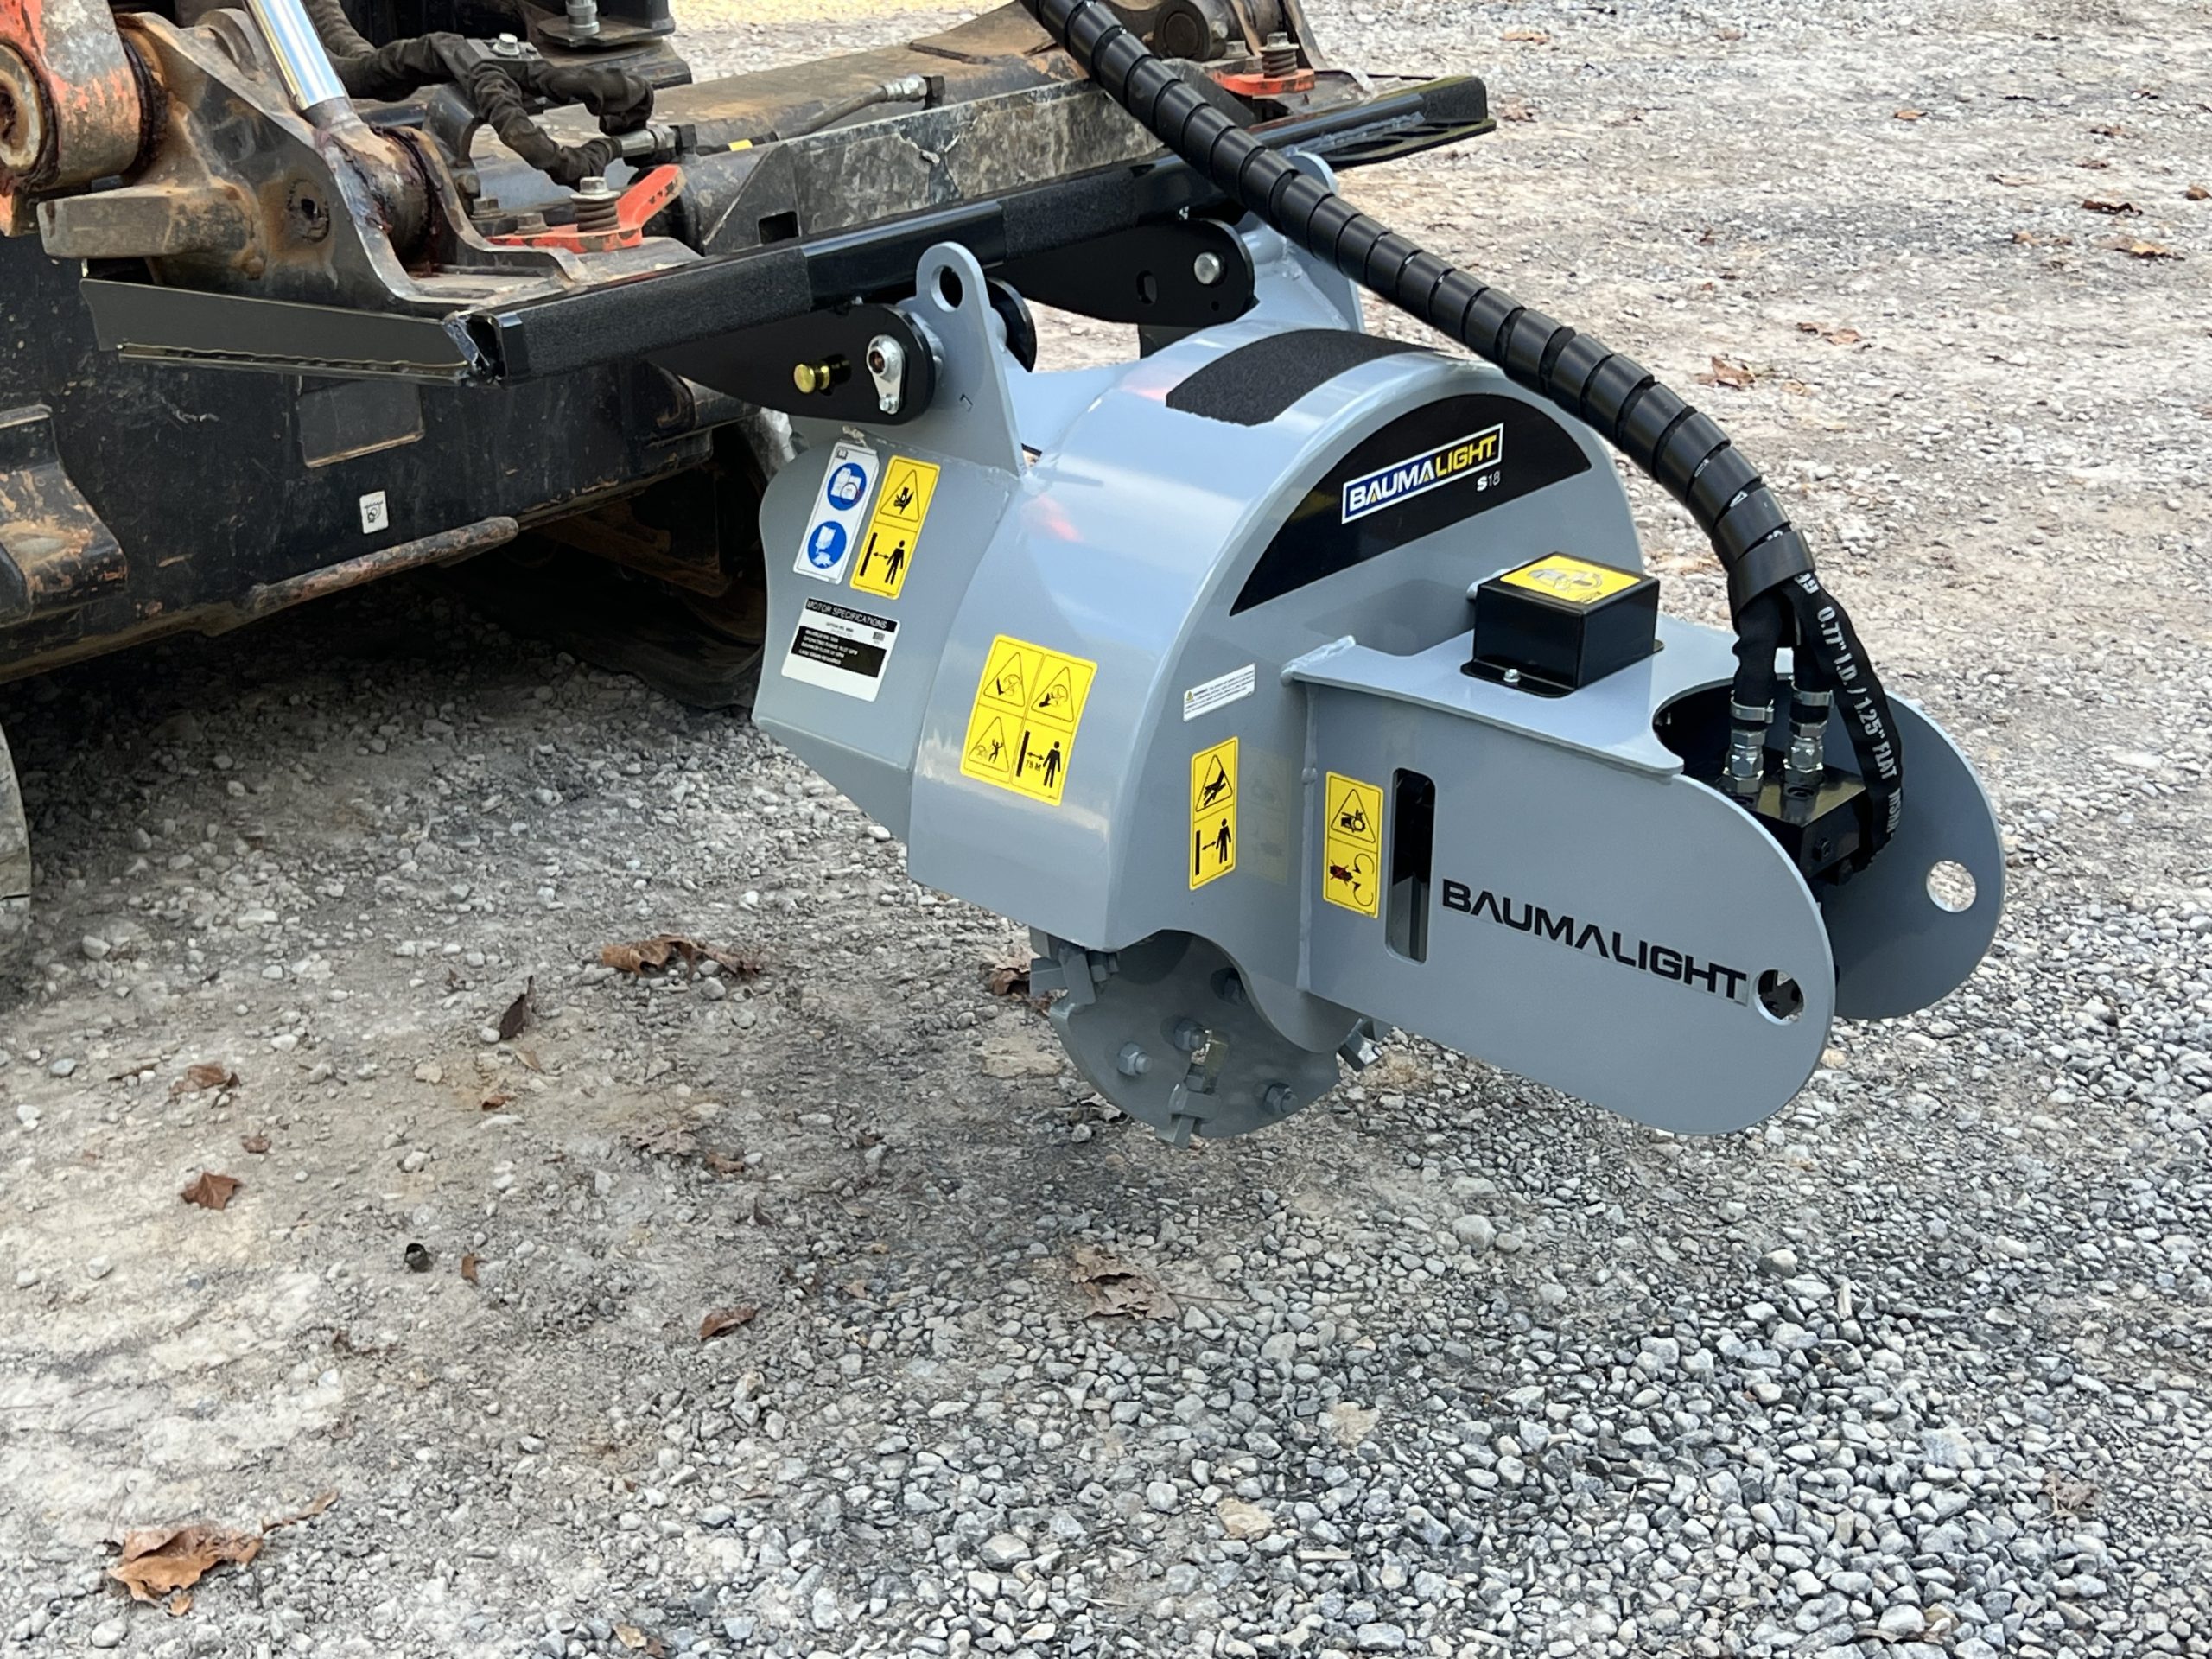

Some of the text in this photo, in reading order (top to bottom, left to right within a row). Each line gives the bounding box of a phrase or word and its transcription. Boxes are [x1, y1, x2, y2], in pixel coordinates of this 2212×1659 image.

[1349, 435, 1497, 512] BAUMALIGHT
[1477, 471, 1501, 492] S18
[807, 600, 832, 614] MOTOR
[832, 607, 888, 630] SPECIFICATIONS
[1817, 606, 1847, 651] 0.77"
[1834, 652, 1858, 686] I.D.
[1853, 696, 1886, 739] 1.25"
[1872, 741, 1897, 779] FLAT
[1442, 879, 1747, 1000] BAUMALIGHT
